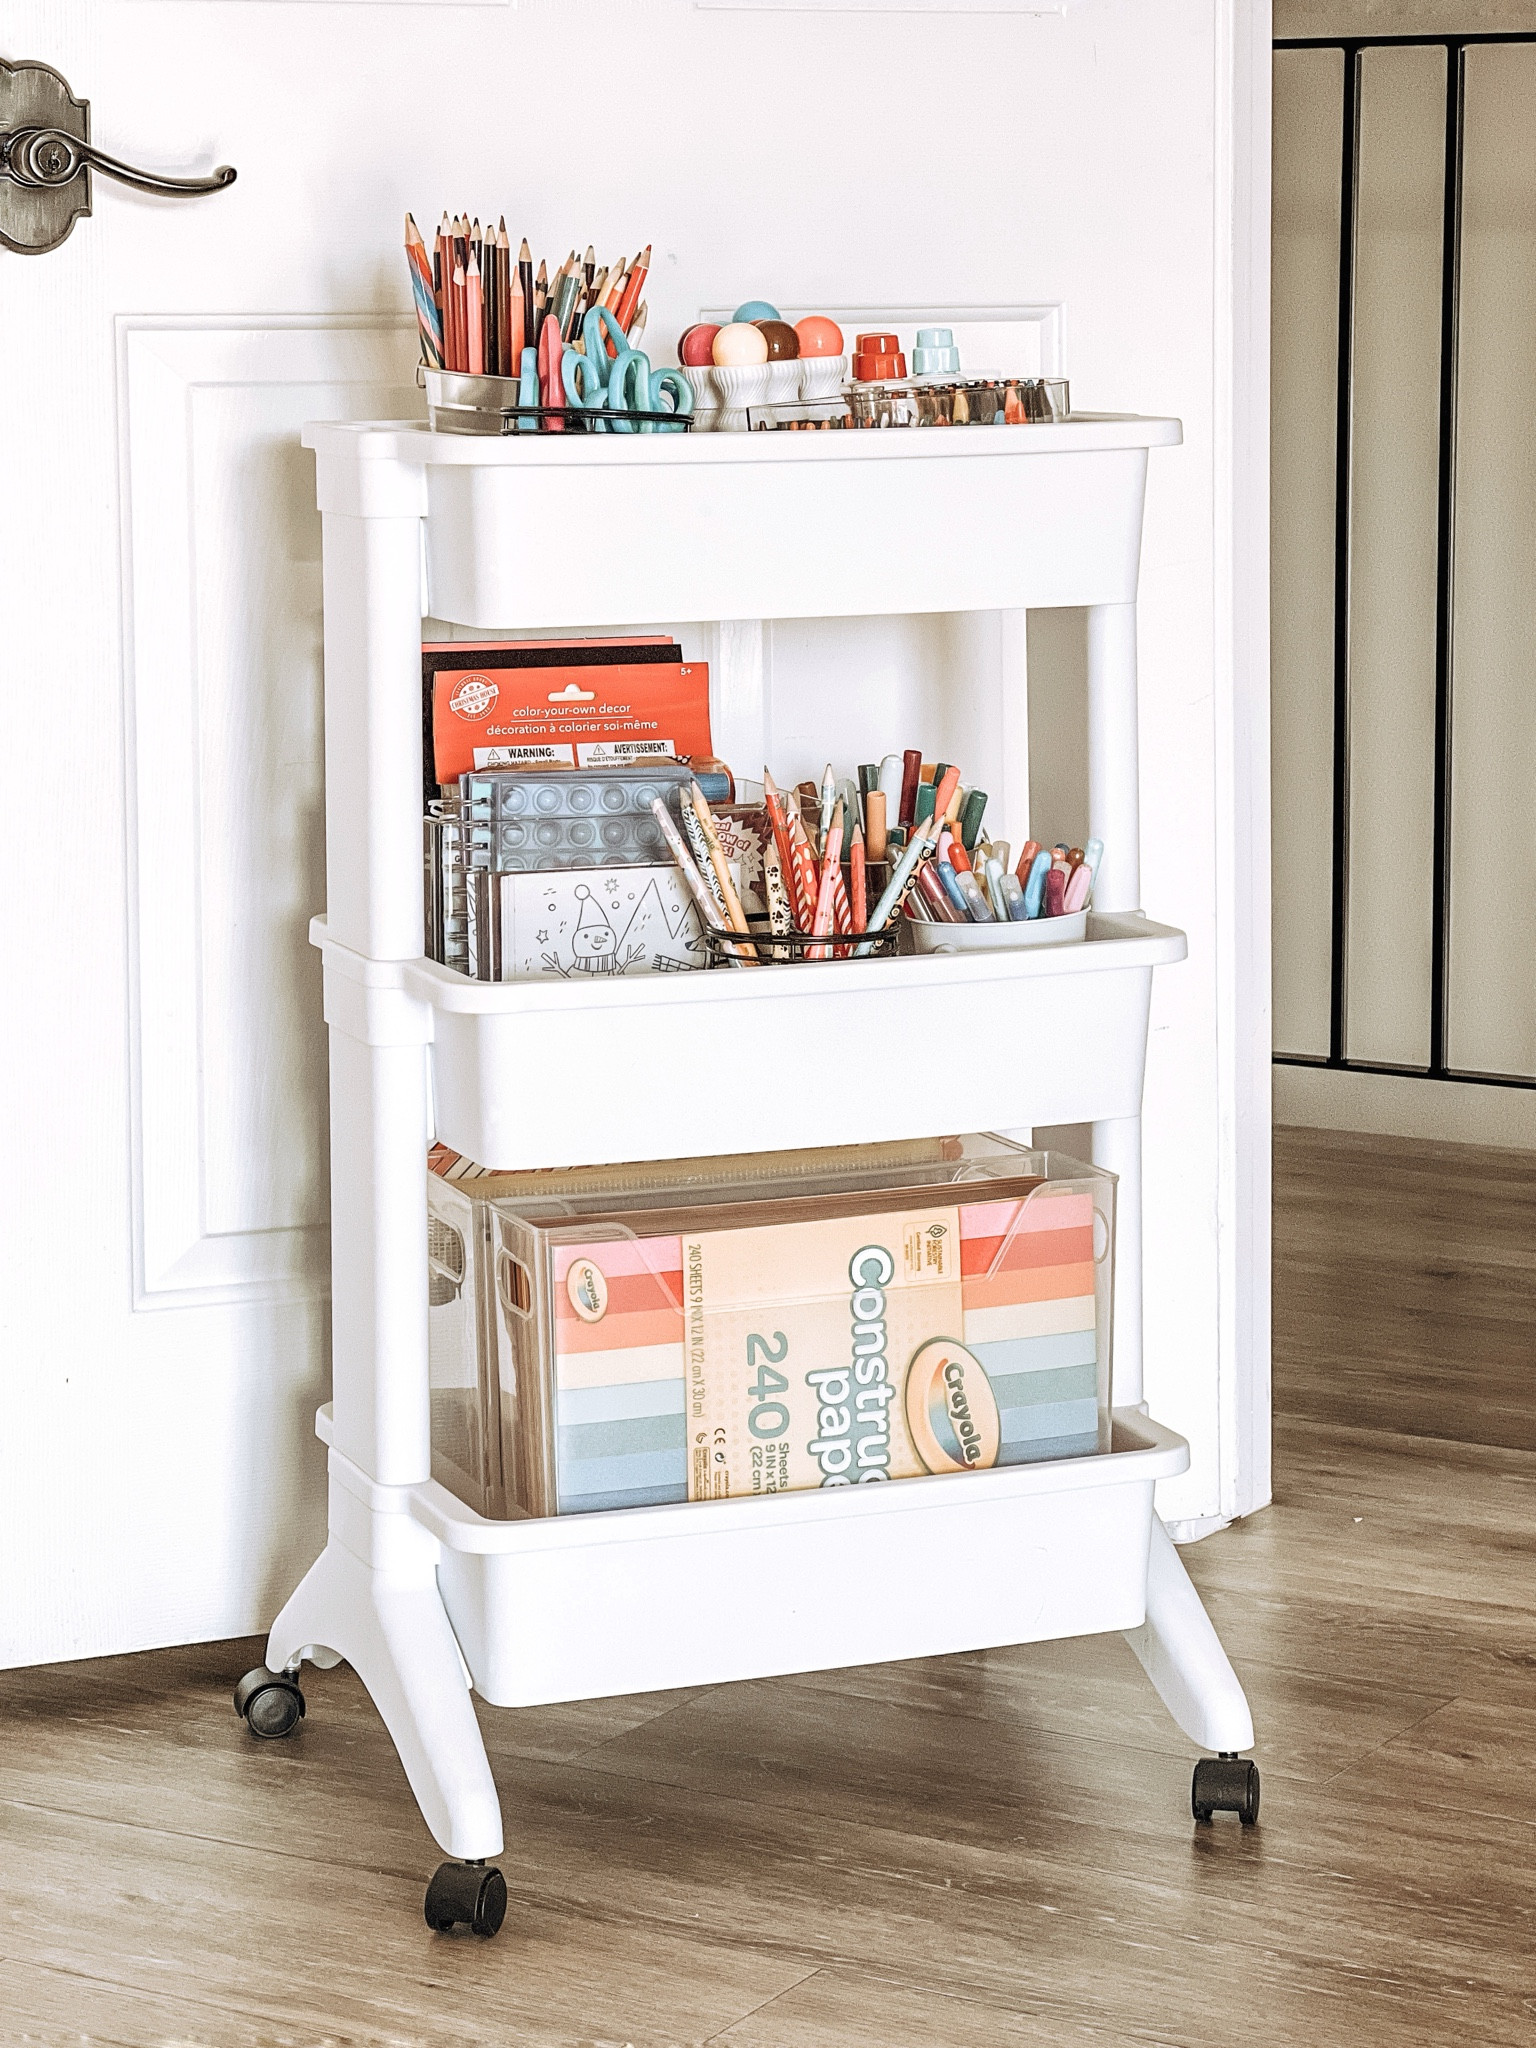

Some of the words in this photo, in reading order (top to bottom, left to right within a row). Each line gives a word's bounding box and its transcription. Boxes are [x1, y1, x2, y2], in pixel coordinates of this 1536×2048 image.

[680, 667, 692, 676] 5+
[451, 694, 480, 710] CHRISTMAS
[479, 687, 497, 699] HOUSE
[512, 705, 596, 719] color-your-own
[598, 704, 631, 714] decor
[486, 723, 547, 736] décoration
[549, 722, 556, 733] à
[558, 721, 601, 733] colorier
[603, 719, 658, 731] soi-même
[508, 747, 555, 759] WARNING:
[614, 742, 668, 754] AVERTISSEMENT:
[736, 840, 751, 851] of
[688, 1244, 702, 1262] 240
[689, 1263, 703, 1296] SHEETS
[584, 1269, 600, 1310] Crayola
[691, 1325, 704, 1335] 12
[691, 1336, 704, 1346] IN
[690, 1348, 705, 1364] (22
[692, 1365, 702, 1378] cm
[746, 1331, 790, 1440] 240
[692, 1387, 706, 1400] 30
[692, 1401, 705, 1418] cm)
[944, 1362, 982, 1462] Crayola
[765, 1444, 776, 1453] 9
[749, 1445, 763, 1468] (22
[765, 1455, 777, 1470] IN
[779, 1442, 790, 1488] Sheets
[752, 1469, 761, 1491] cm
[766, 1480, 777, 1494] 12
